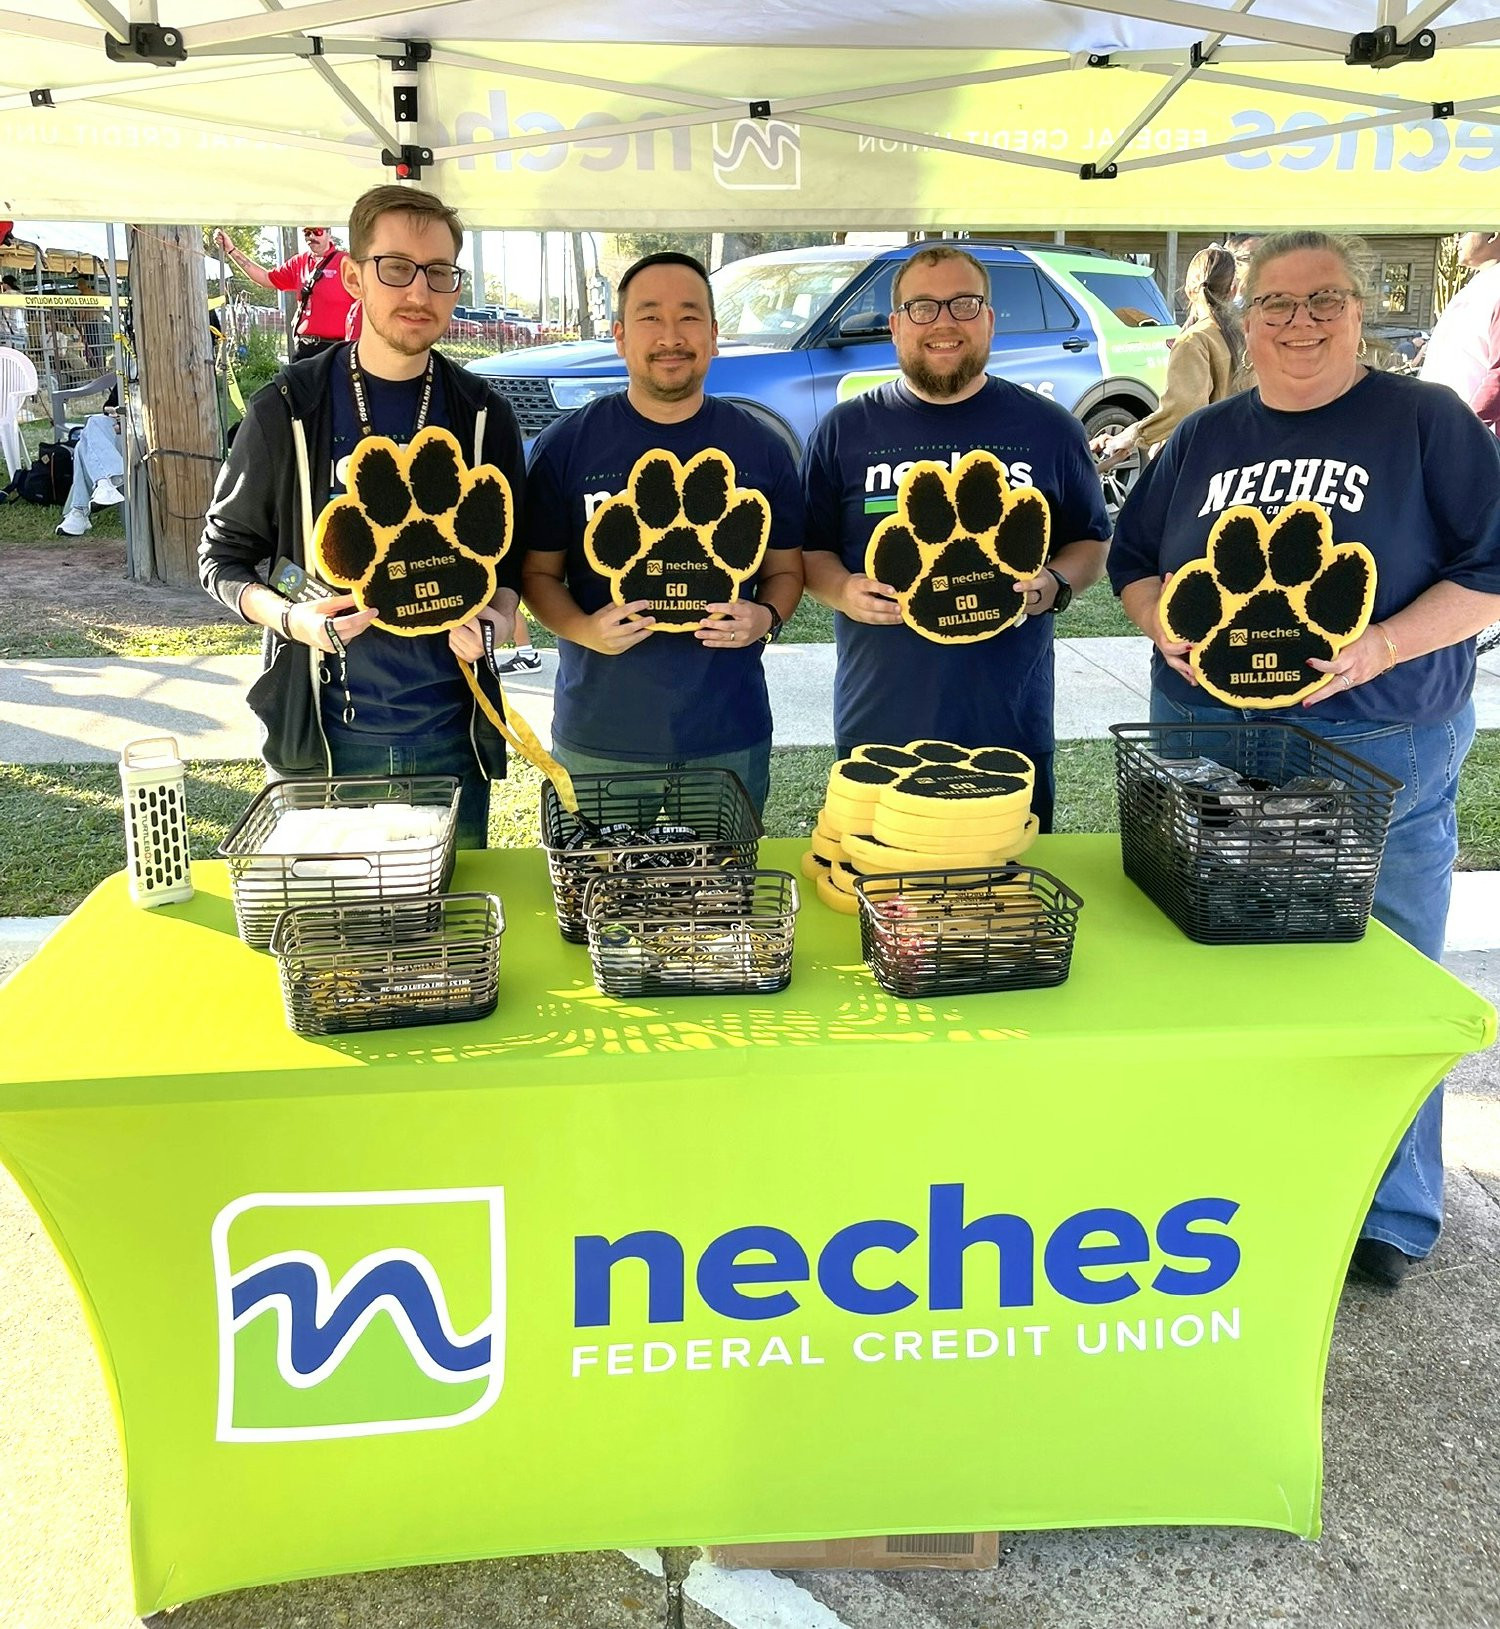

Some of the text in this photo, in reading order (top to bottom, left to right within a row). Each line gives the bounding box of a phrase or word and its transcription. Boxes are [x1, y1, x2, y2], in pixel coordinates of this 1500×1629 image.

[1197, 458, 1370, 518] NECHES
[409, 554, 457, 571] neches
[666, 560, 709, 571] neches
[951, 570, 996, 585] neches
[414, 580, 441, 600] GO
[665, 582, 689, 598] GO
[395, 594, 465, 618] BULLDOGS
[647, 600, 708, 611] BULLDOGS
[955, 593, 979, 611] GO
[937, 608, 1001, 627] BULLDOGS
[1251, 627, 1301, 640] neches
[1251, 652, 1278, 669] GO
[1229, 670, 1301, 685] BULLDOGS
[948, 781, 978, 791] GO
[141, 814, 153, 865] TURTLEBOX
[573, 1182, 1241, 1328] neches
[571, 1307, 1241, 1378] FEDERAL CREDIT UNION
